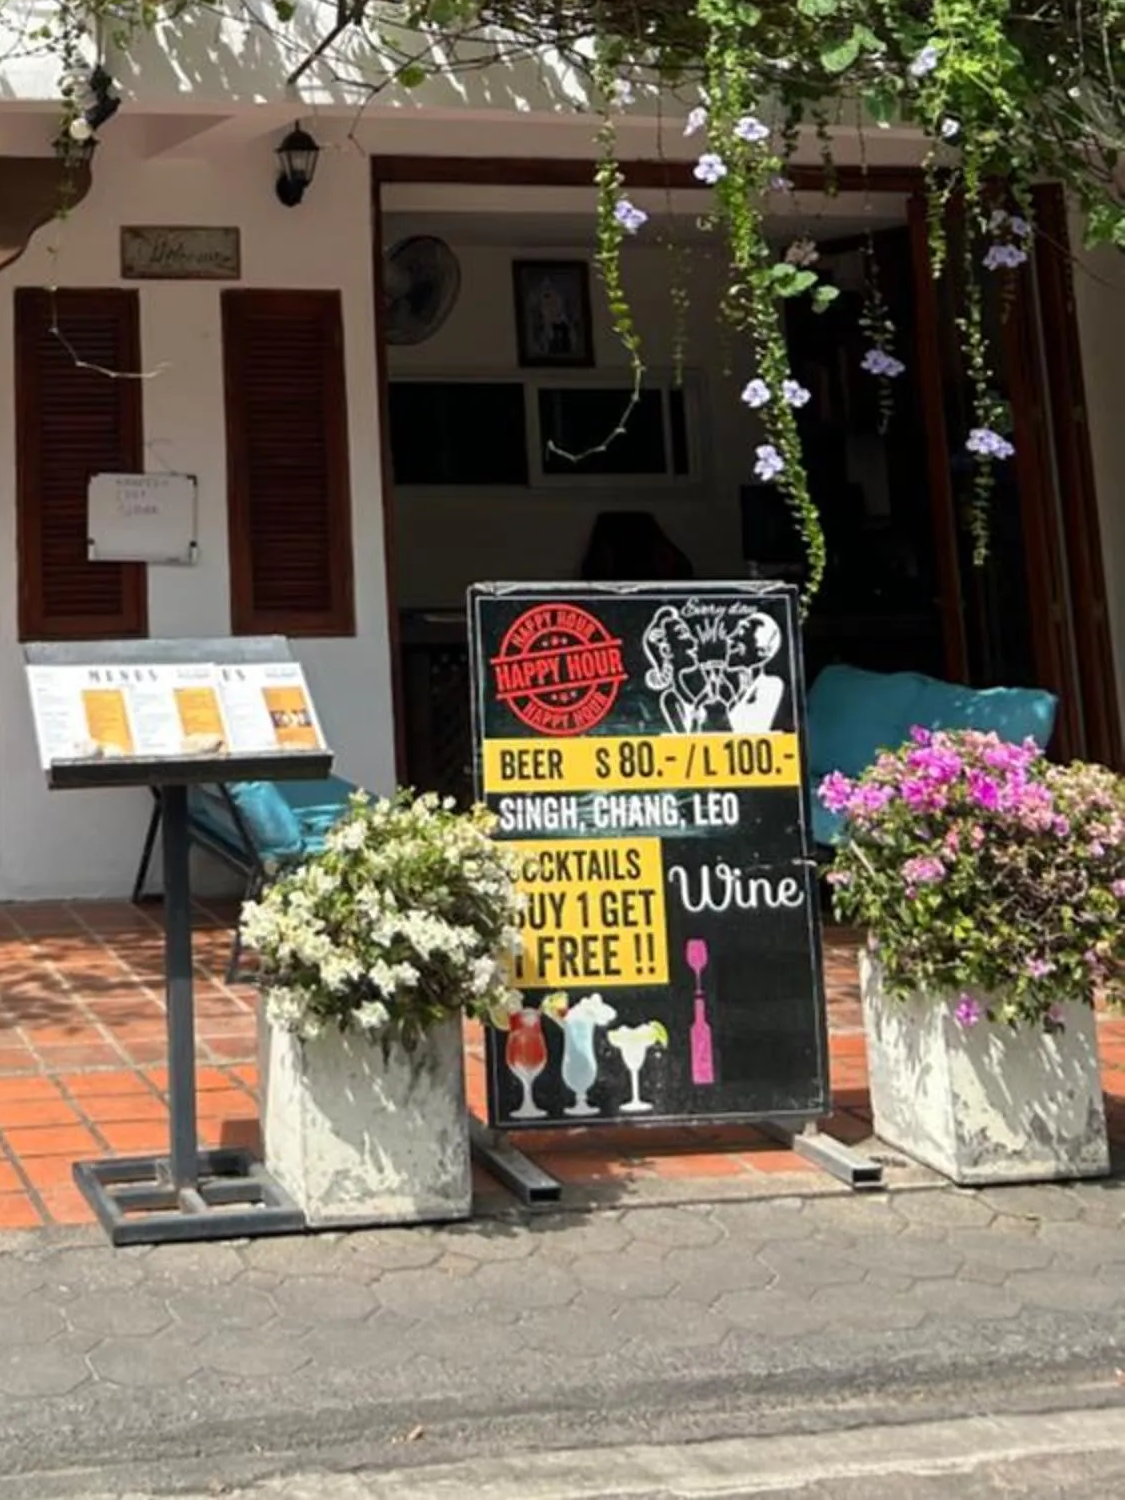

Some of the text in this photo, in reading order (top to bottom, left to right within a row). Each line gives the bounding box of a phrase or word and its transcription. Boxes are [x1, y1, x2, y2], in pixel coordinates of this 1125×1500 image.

[511, 611, 596, 648] HAPPY HOUR
[495, 647, 624, 692] HAPPY HOUR
[500, 748, 565, 781] BEER
[596, 746, 612, 780] S
[619, 739, 677, 778] 80.-
[704, 745, 718, 777] L
[723, 738, 795, 776] 100.-
[498, 791, 741, 833] SINGH, CHANG, LEO
[577, 891, 590, 929] 1
[600, 888, 657, 928] GET
[668, 862, 806, 914] Wine
[537, 933, 622, 979] FREE
[633, 932, 657, 976] !!
